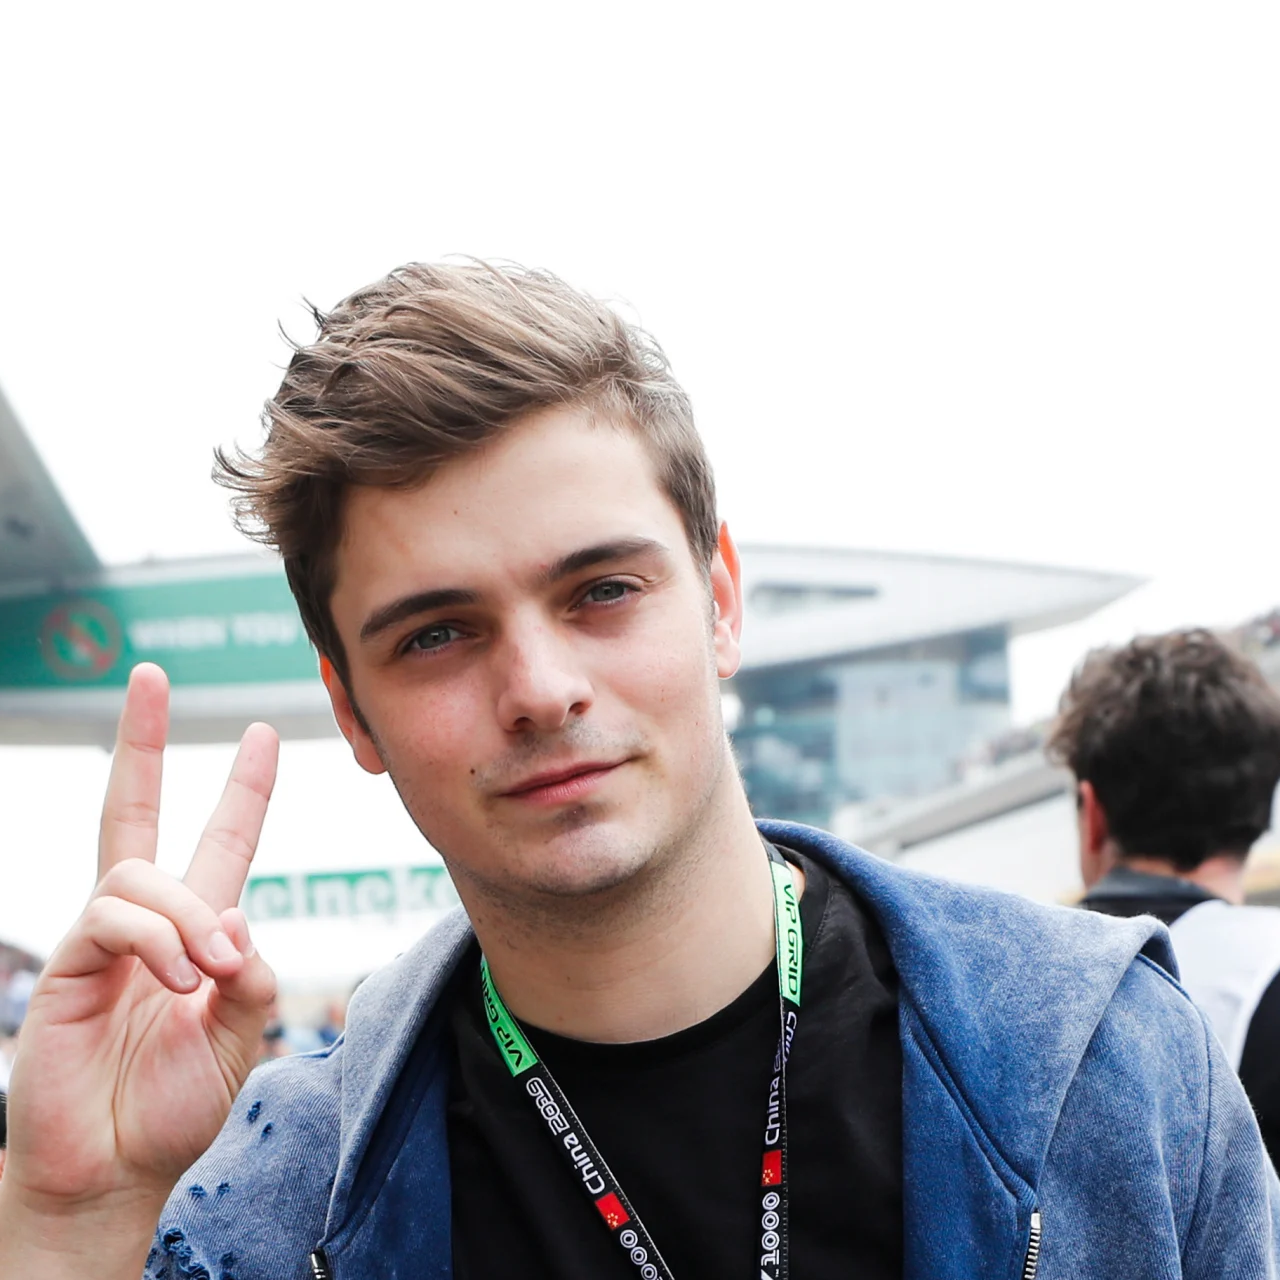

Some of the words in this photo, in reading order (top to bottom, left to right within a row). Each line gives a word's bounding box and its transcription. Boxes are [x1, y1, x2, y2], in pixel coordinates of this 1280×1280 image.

[129, 619, 227, 650] WHEN
[232, 612, 298, 644] YOU
[251, 866, 460, 919] eineke
[783, 883, 797, 924] VIP
[787, 928, 799, 996] GRID
[496, 1026, 523, 1068] VIP
[765, 1076, 781, 1146] China
[563, 1132, 605, 1194] China
[761, 1192, 780, 1266] 1000
